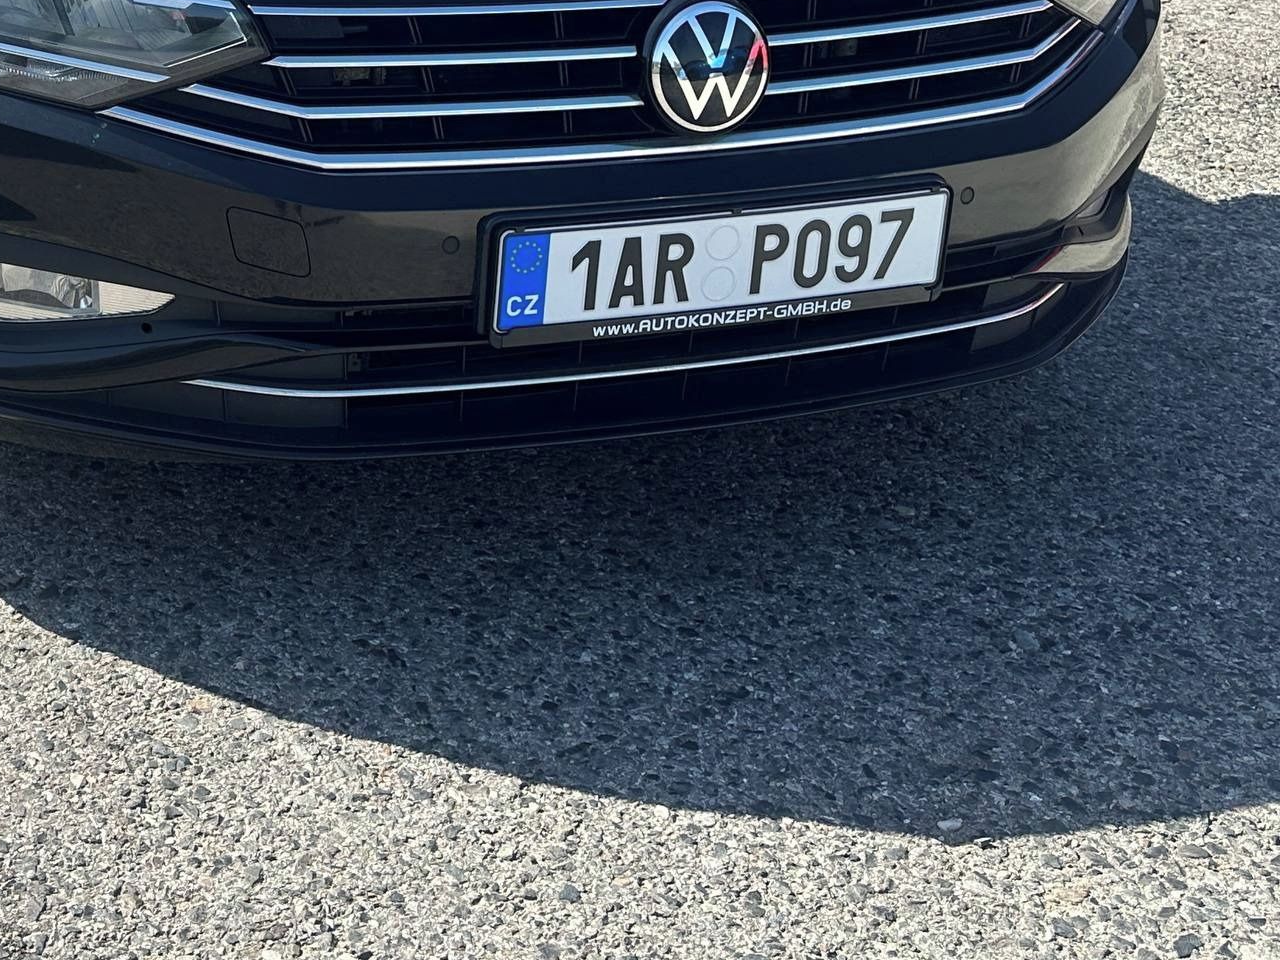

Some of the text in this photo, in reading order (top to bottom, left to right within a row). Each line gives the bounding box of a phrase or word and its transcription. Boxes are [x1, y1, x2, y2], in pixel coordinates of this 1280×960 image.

[570, 207, 915, 311] 1AR P097
[506, 294, 539, 317] CZ
[592, 298, 852, 337] www.AUTOKONZEPT-GMBH.de
